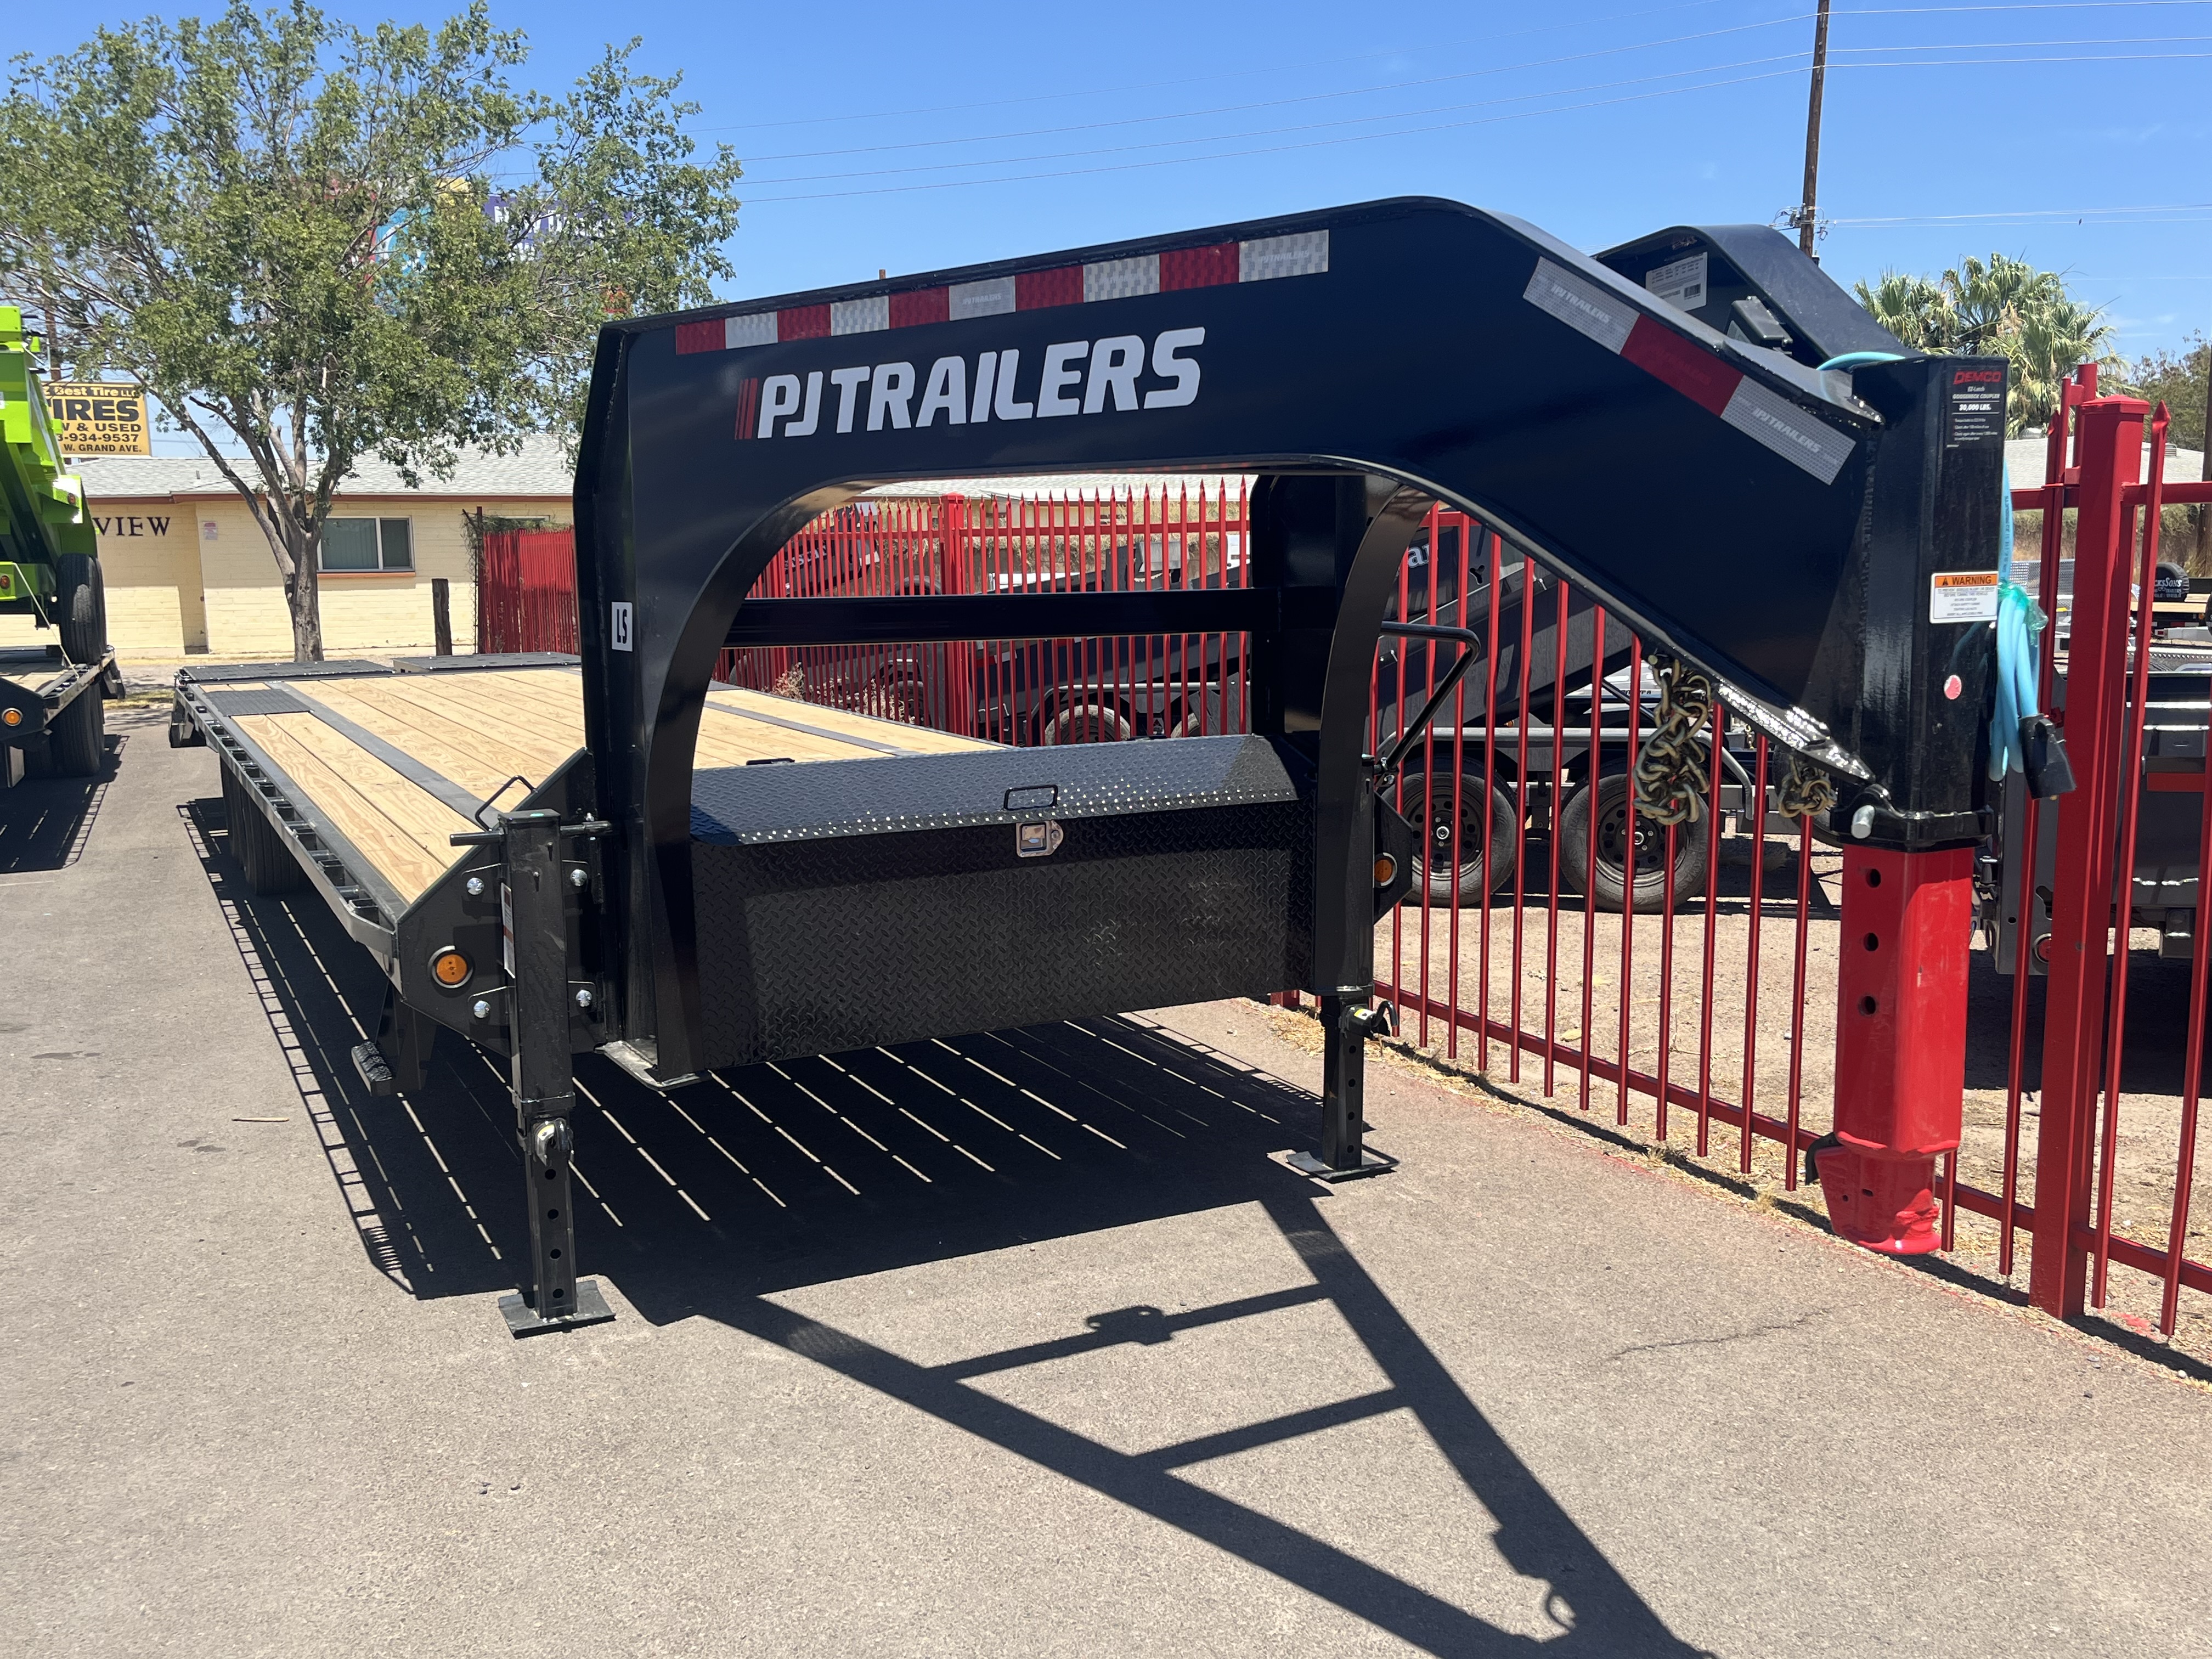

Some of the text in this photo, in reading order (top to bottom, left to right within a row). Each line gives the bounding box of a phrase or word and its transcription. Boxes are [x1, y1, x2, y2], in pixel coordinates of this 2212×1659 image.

[1953, 370, 2002, 385] DEMCO
[54, 386, 87, 396] Best
[91, 387, 119, 396] Tire
[48, 399, 139, 422] IRES
[76, 423, 89, 432] &
[95, 422, 142, 432] USED
[92, 516, 171, 537] VIEW
[1952, 575, 1992, 585] WARNING
